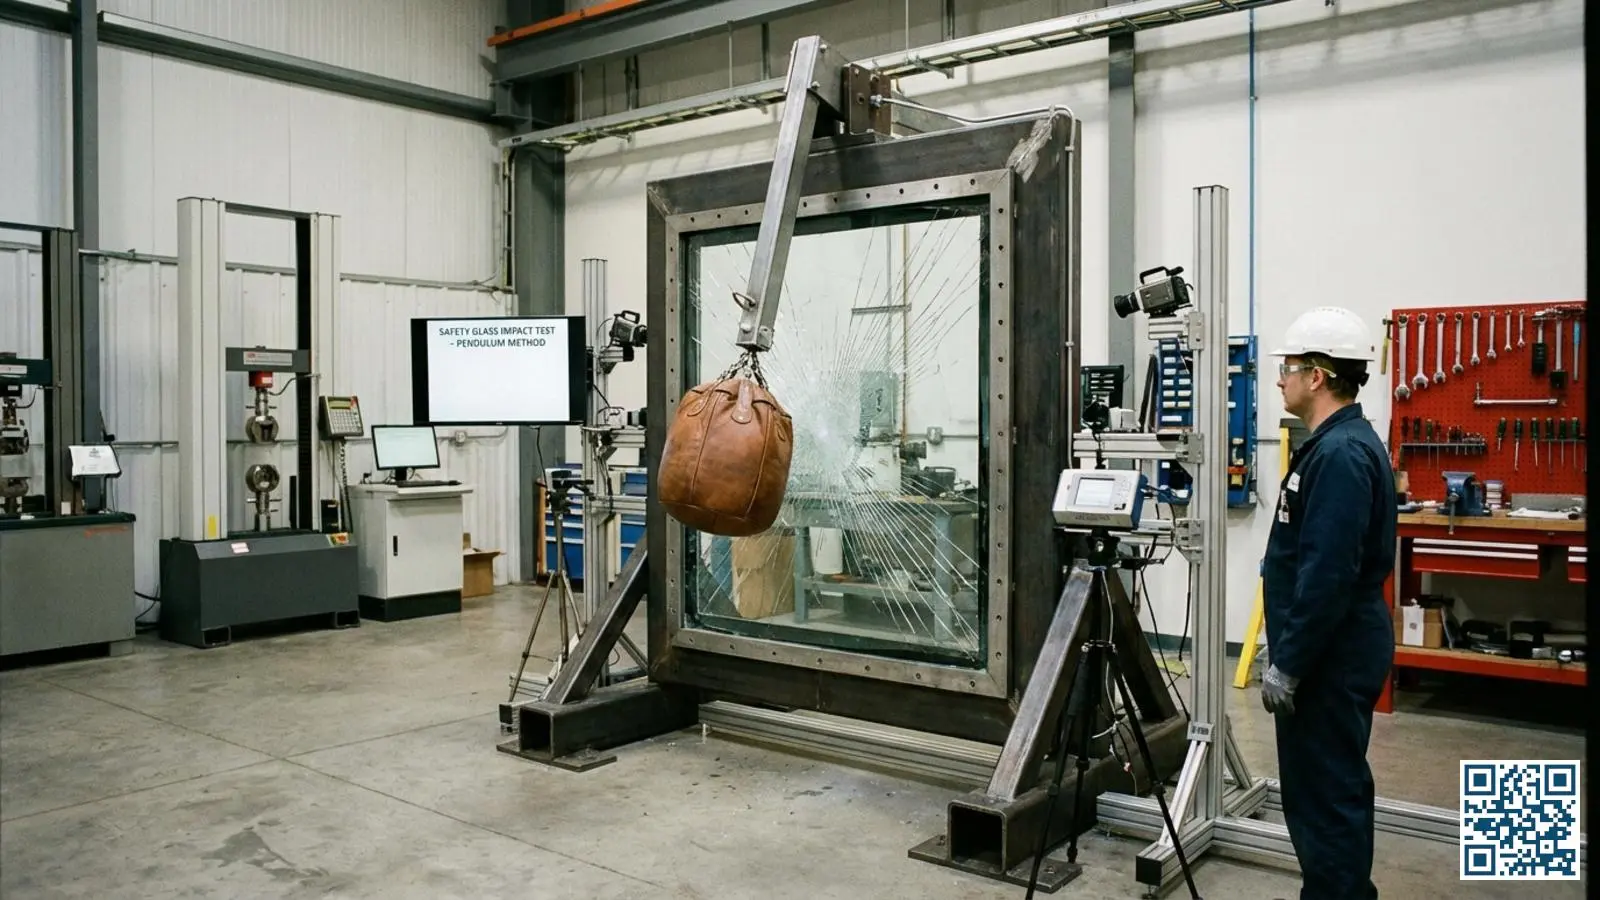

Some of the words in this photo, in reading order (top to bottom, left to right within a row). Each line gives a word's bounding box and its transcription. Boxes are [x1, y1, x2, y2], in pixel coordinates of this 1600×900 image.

[439, 327, 470, 336] SAFETY
[472, 327, 499, 336] GLASS
[501, 326, 533, 335] IMPACT
[535, 326, 556, 335] TEST
[456, 339, 505, 347] PENDULUM
[508, 338, 546, 347] METHOD
